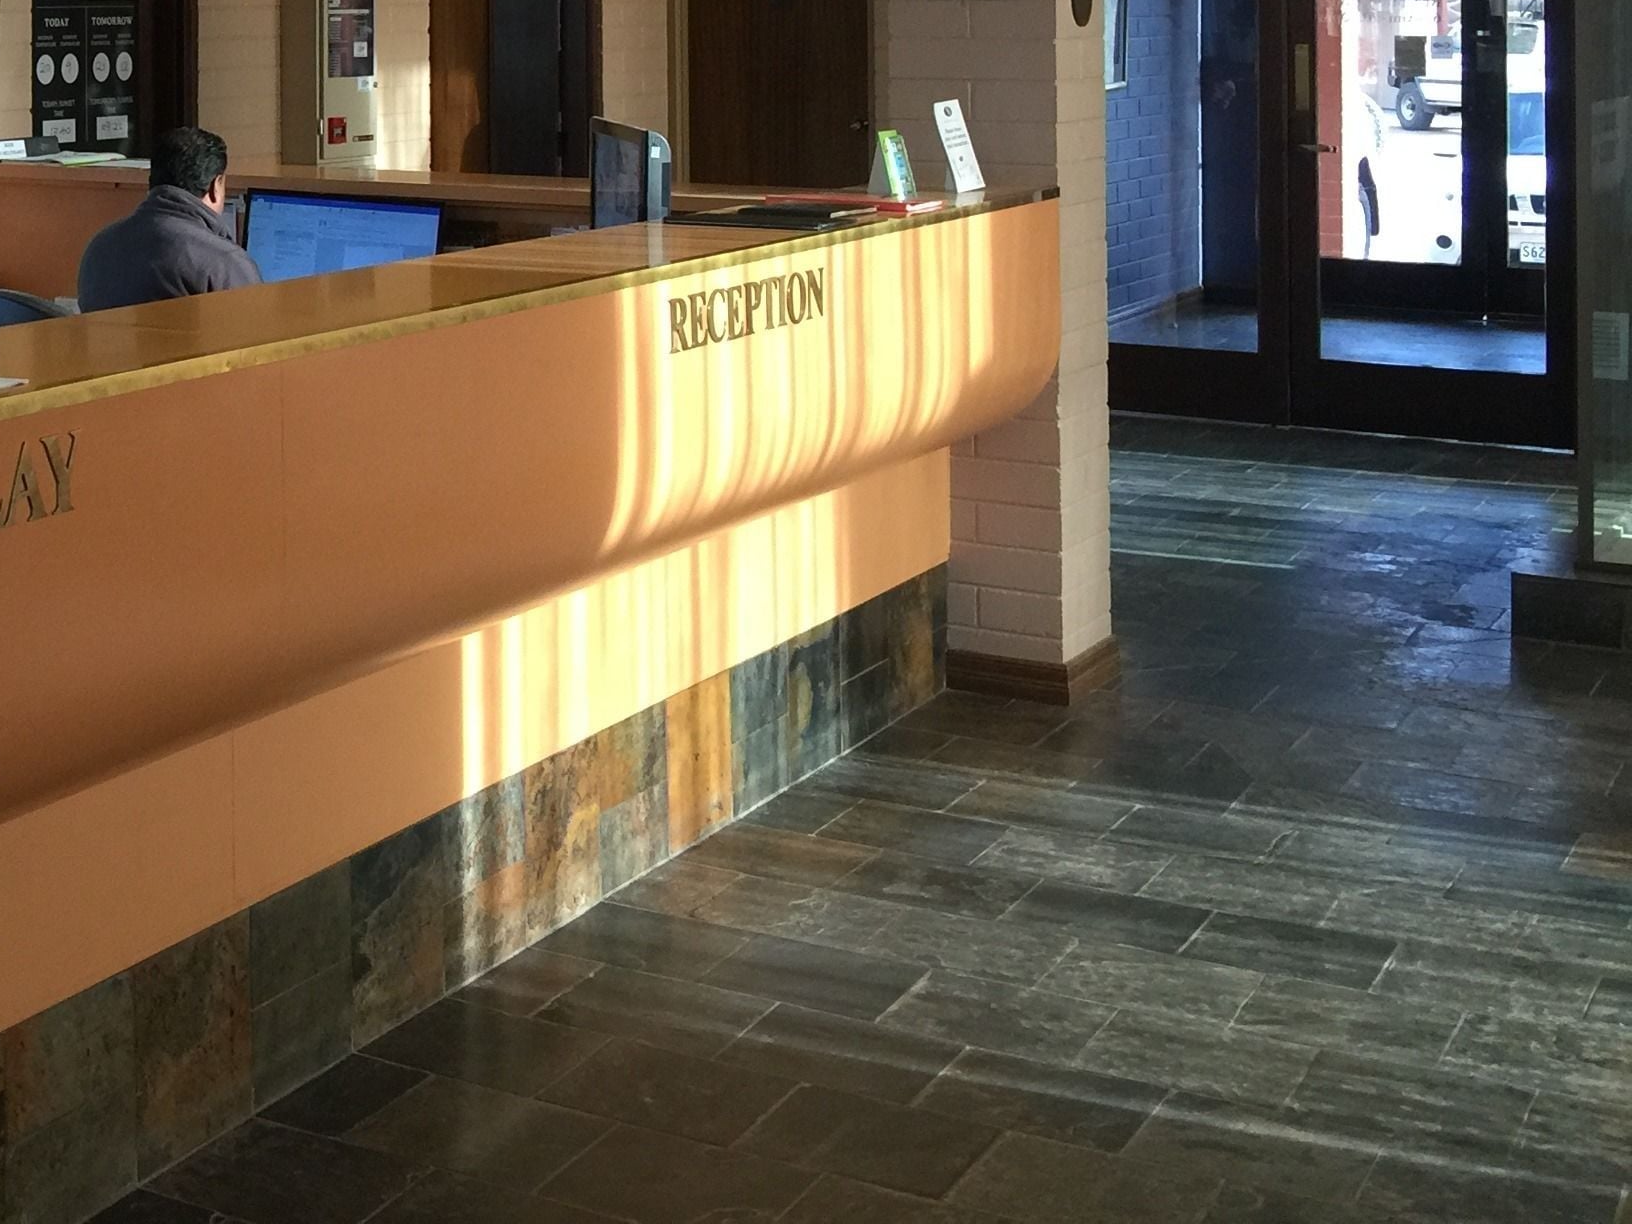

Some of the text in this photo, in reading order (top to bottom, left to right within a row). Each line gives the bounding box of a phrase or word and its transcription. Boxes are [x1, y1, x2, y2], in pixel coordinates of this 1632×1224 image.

[44, 17, 70, 28] TODAY
[91, 16, 134, 26] TOMORROW
[668, 267, 824, 354] RECEPTION
